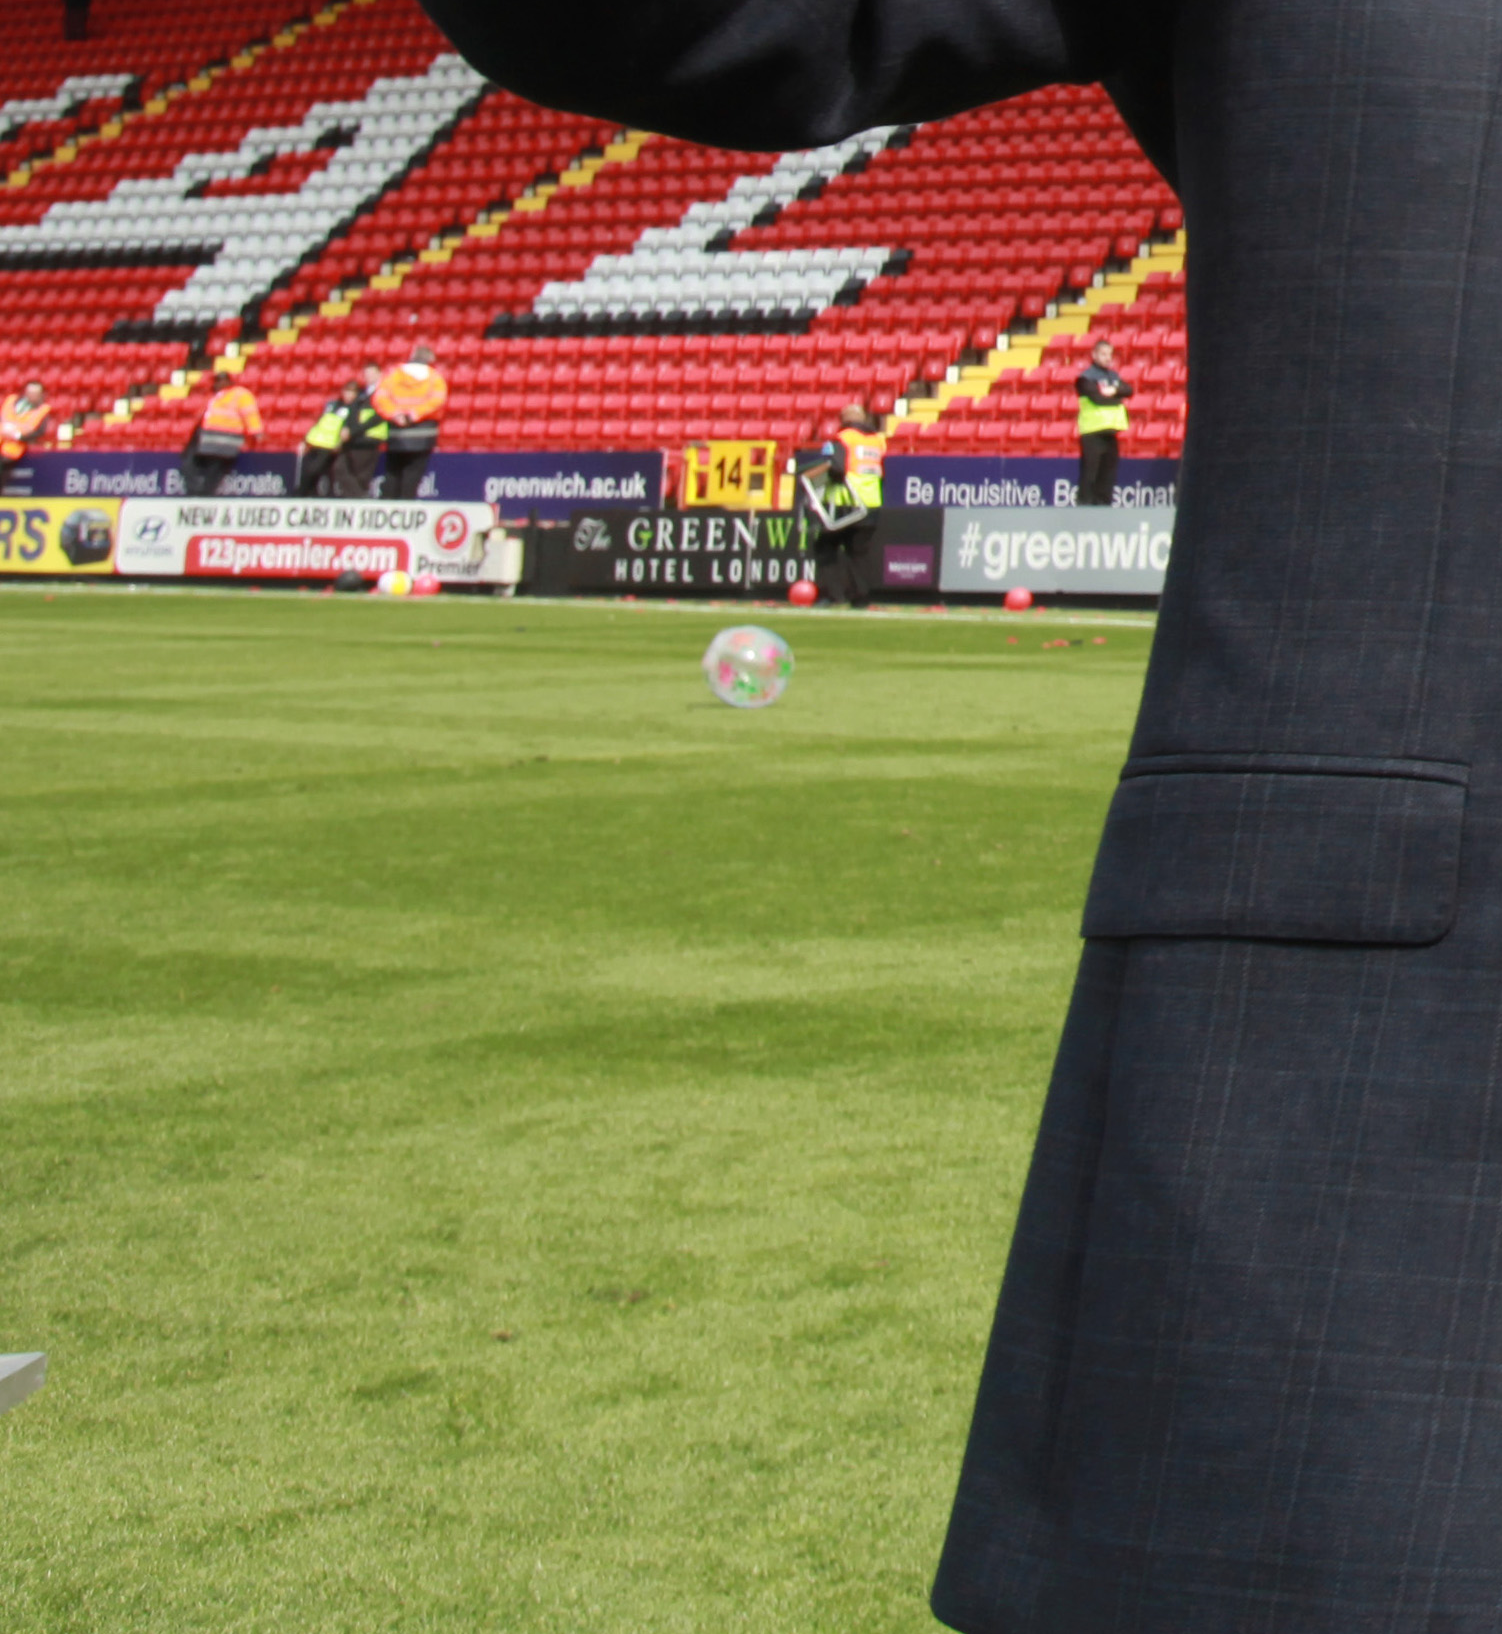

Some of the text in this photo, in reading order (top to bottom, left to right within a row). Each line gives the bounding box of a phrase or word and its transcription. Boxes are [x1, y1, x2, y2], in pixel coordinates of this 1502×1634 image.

[64, 468, 89, 495] Be
[91, 468, 161, 495] involved.
[484, 472, 646, 504] greenwich.ac.uk
[715, 456, 743, 491] 14
[905, 476, 935, 505] Be
[939, 477, 1046, 509] inquisitive.
[178, 506, 427, 530] NEW & USED CARS IN SIDCUP
[627, 517, 820, 552] GREENWI
[199, 537, 399, 571] 123premier.com
[417, 554, 481, 574] Premier
[614, 558, 816, 584] HOTEL LONDON
